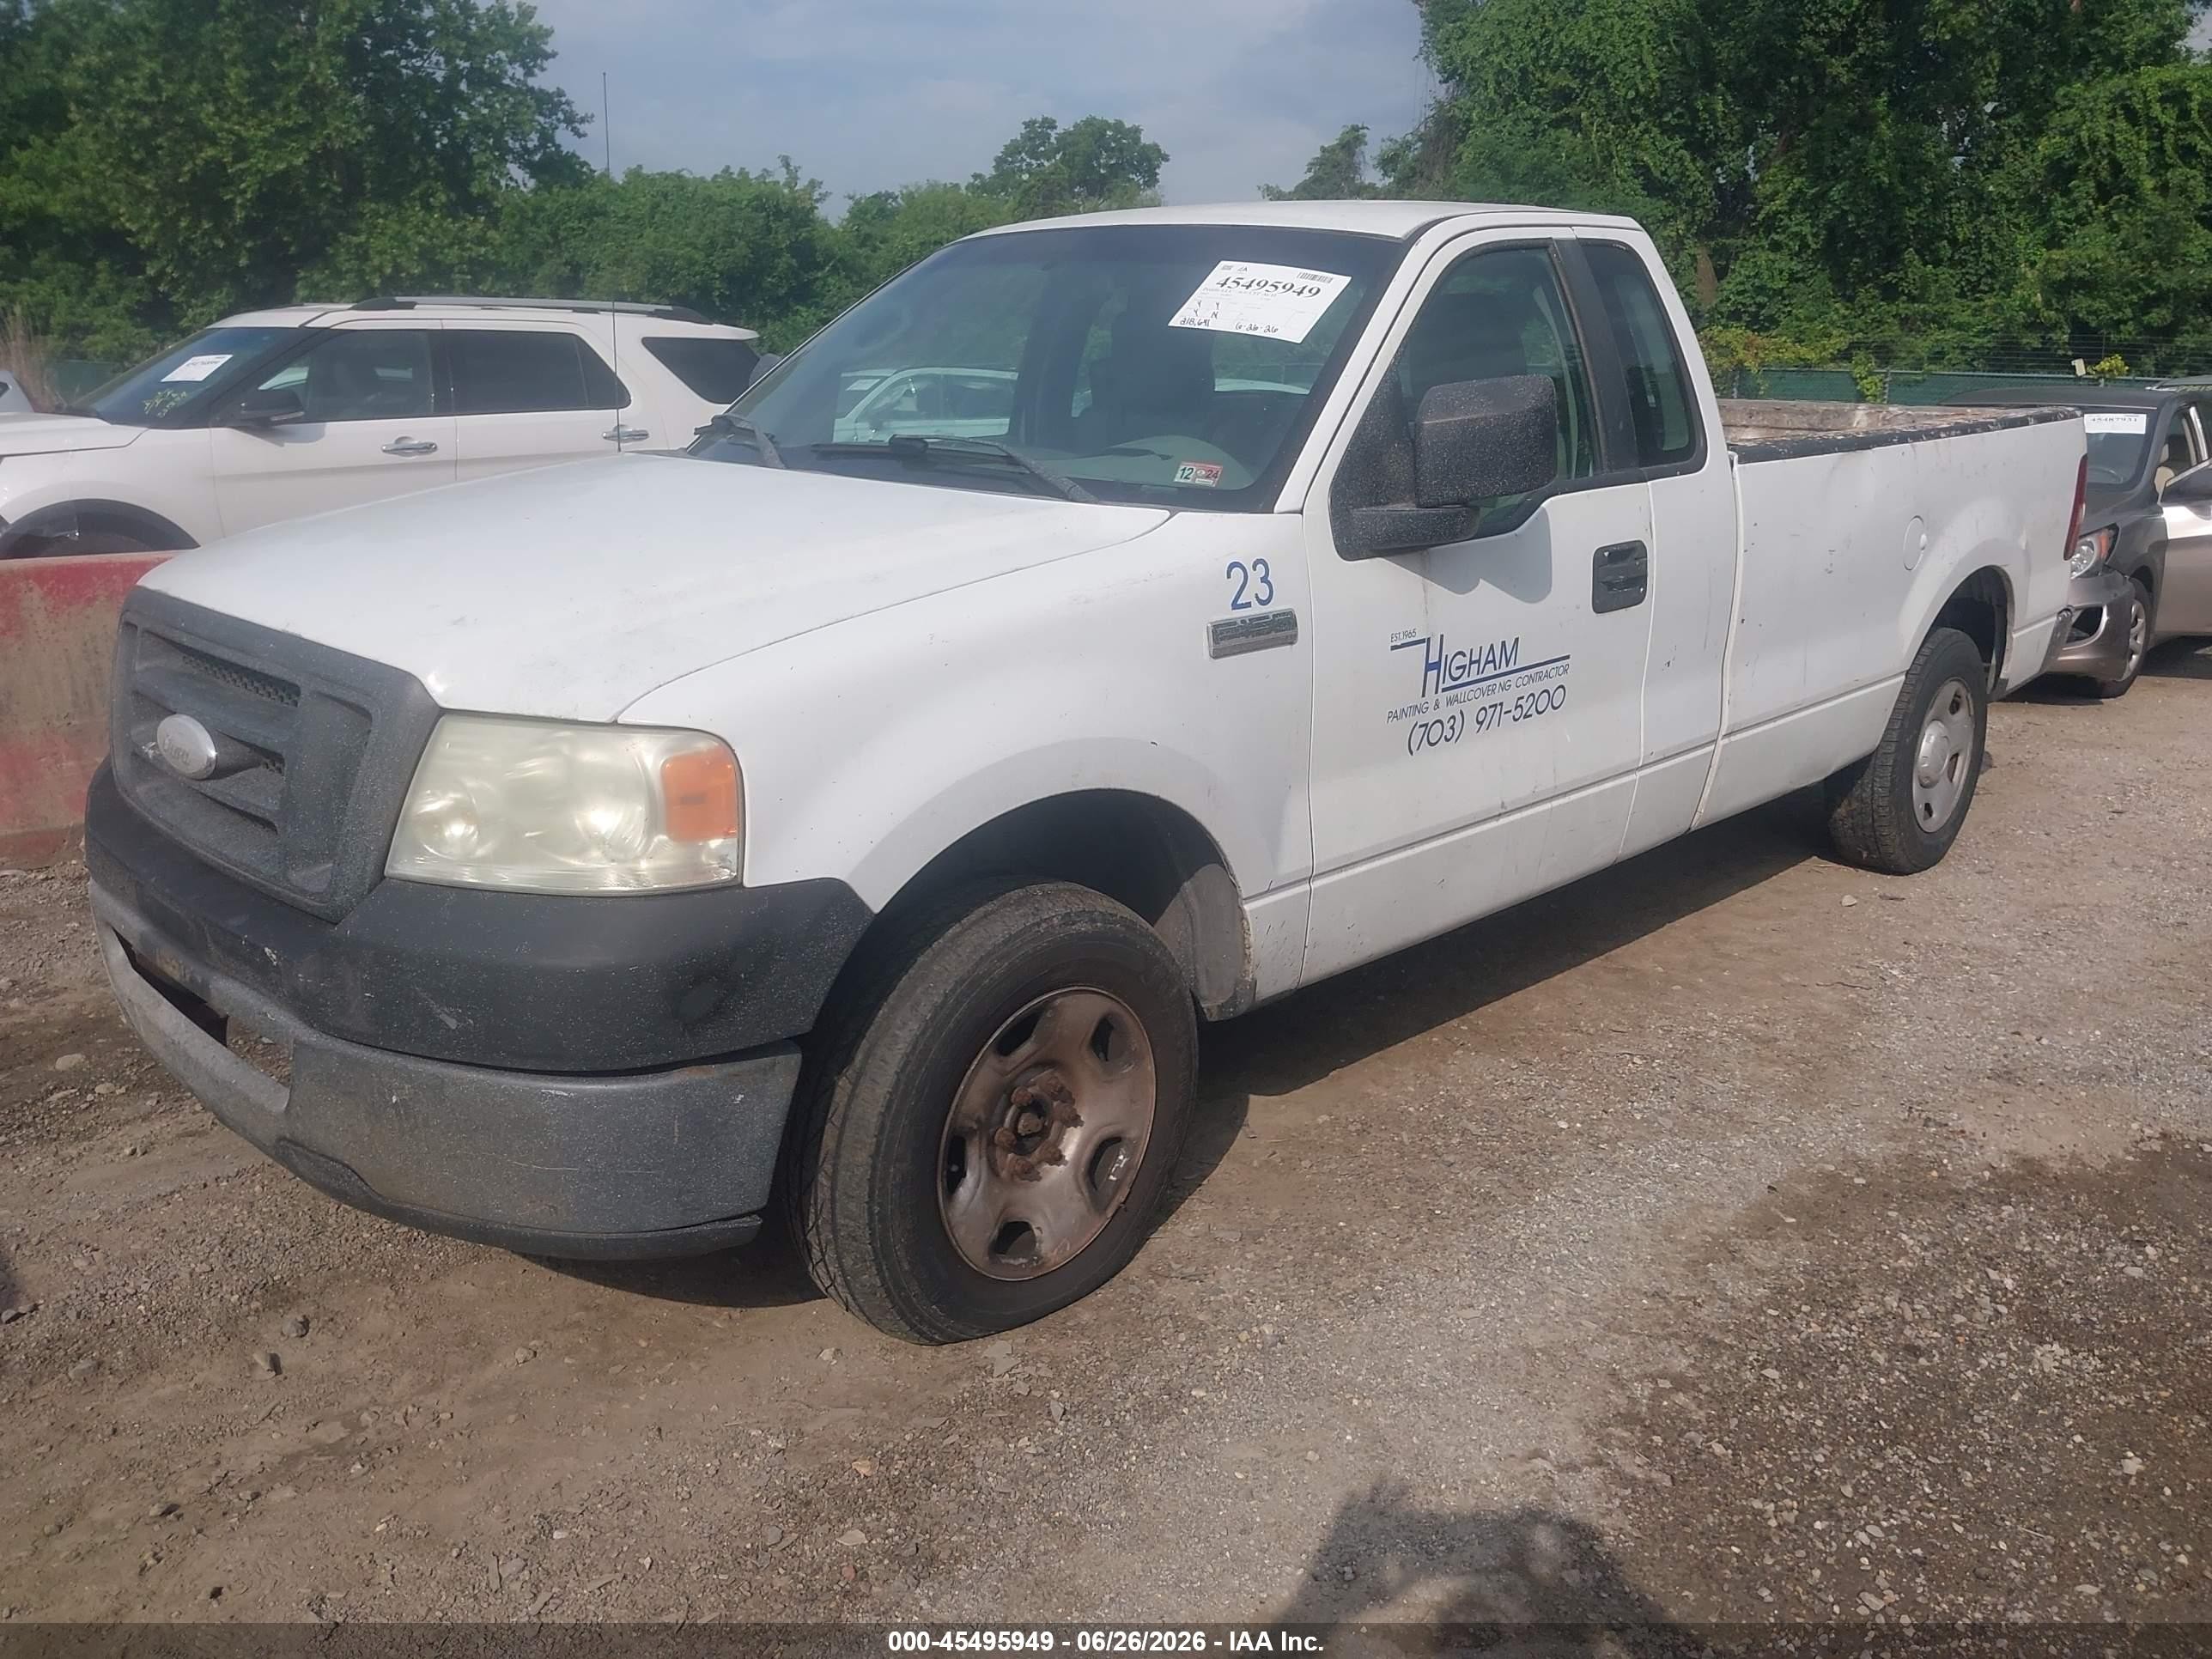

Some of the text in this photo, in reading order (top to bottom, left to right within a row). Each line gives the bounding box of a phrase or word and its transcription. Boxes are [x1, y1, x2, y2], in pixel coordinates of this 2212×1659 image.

[1215, 276, 1322, 298] 45495949
[1180, 466, 1219, 480] 12 24
[1226, 558, 1273, 611] 23
[1386, 701, 1430, 724] PAINTING
[1433, 698, 1440, 711] &
[1516, 664, 1570, 689] CONTRACTOR
[1407, 684, 1567, 756] (703) 971-5200
